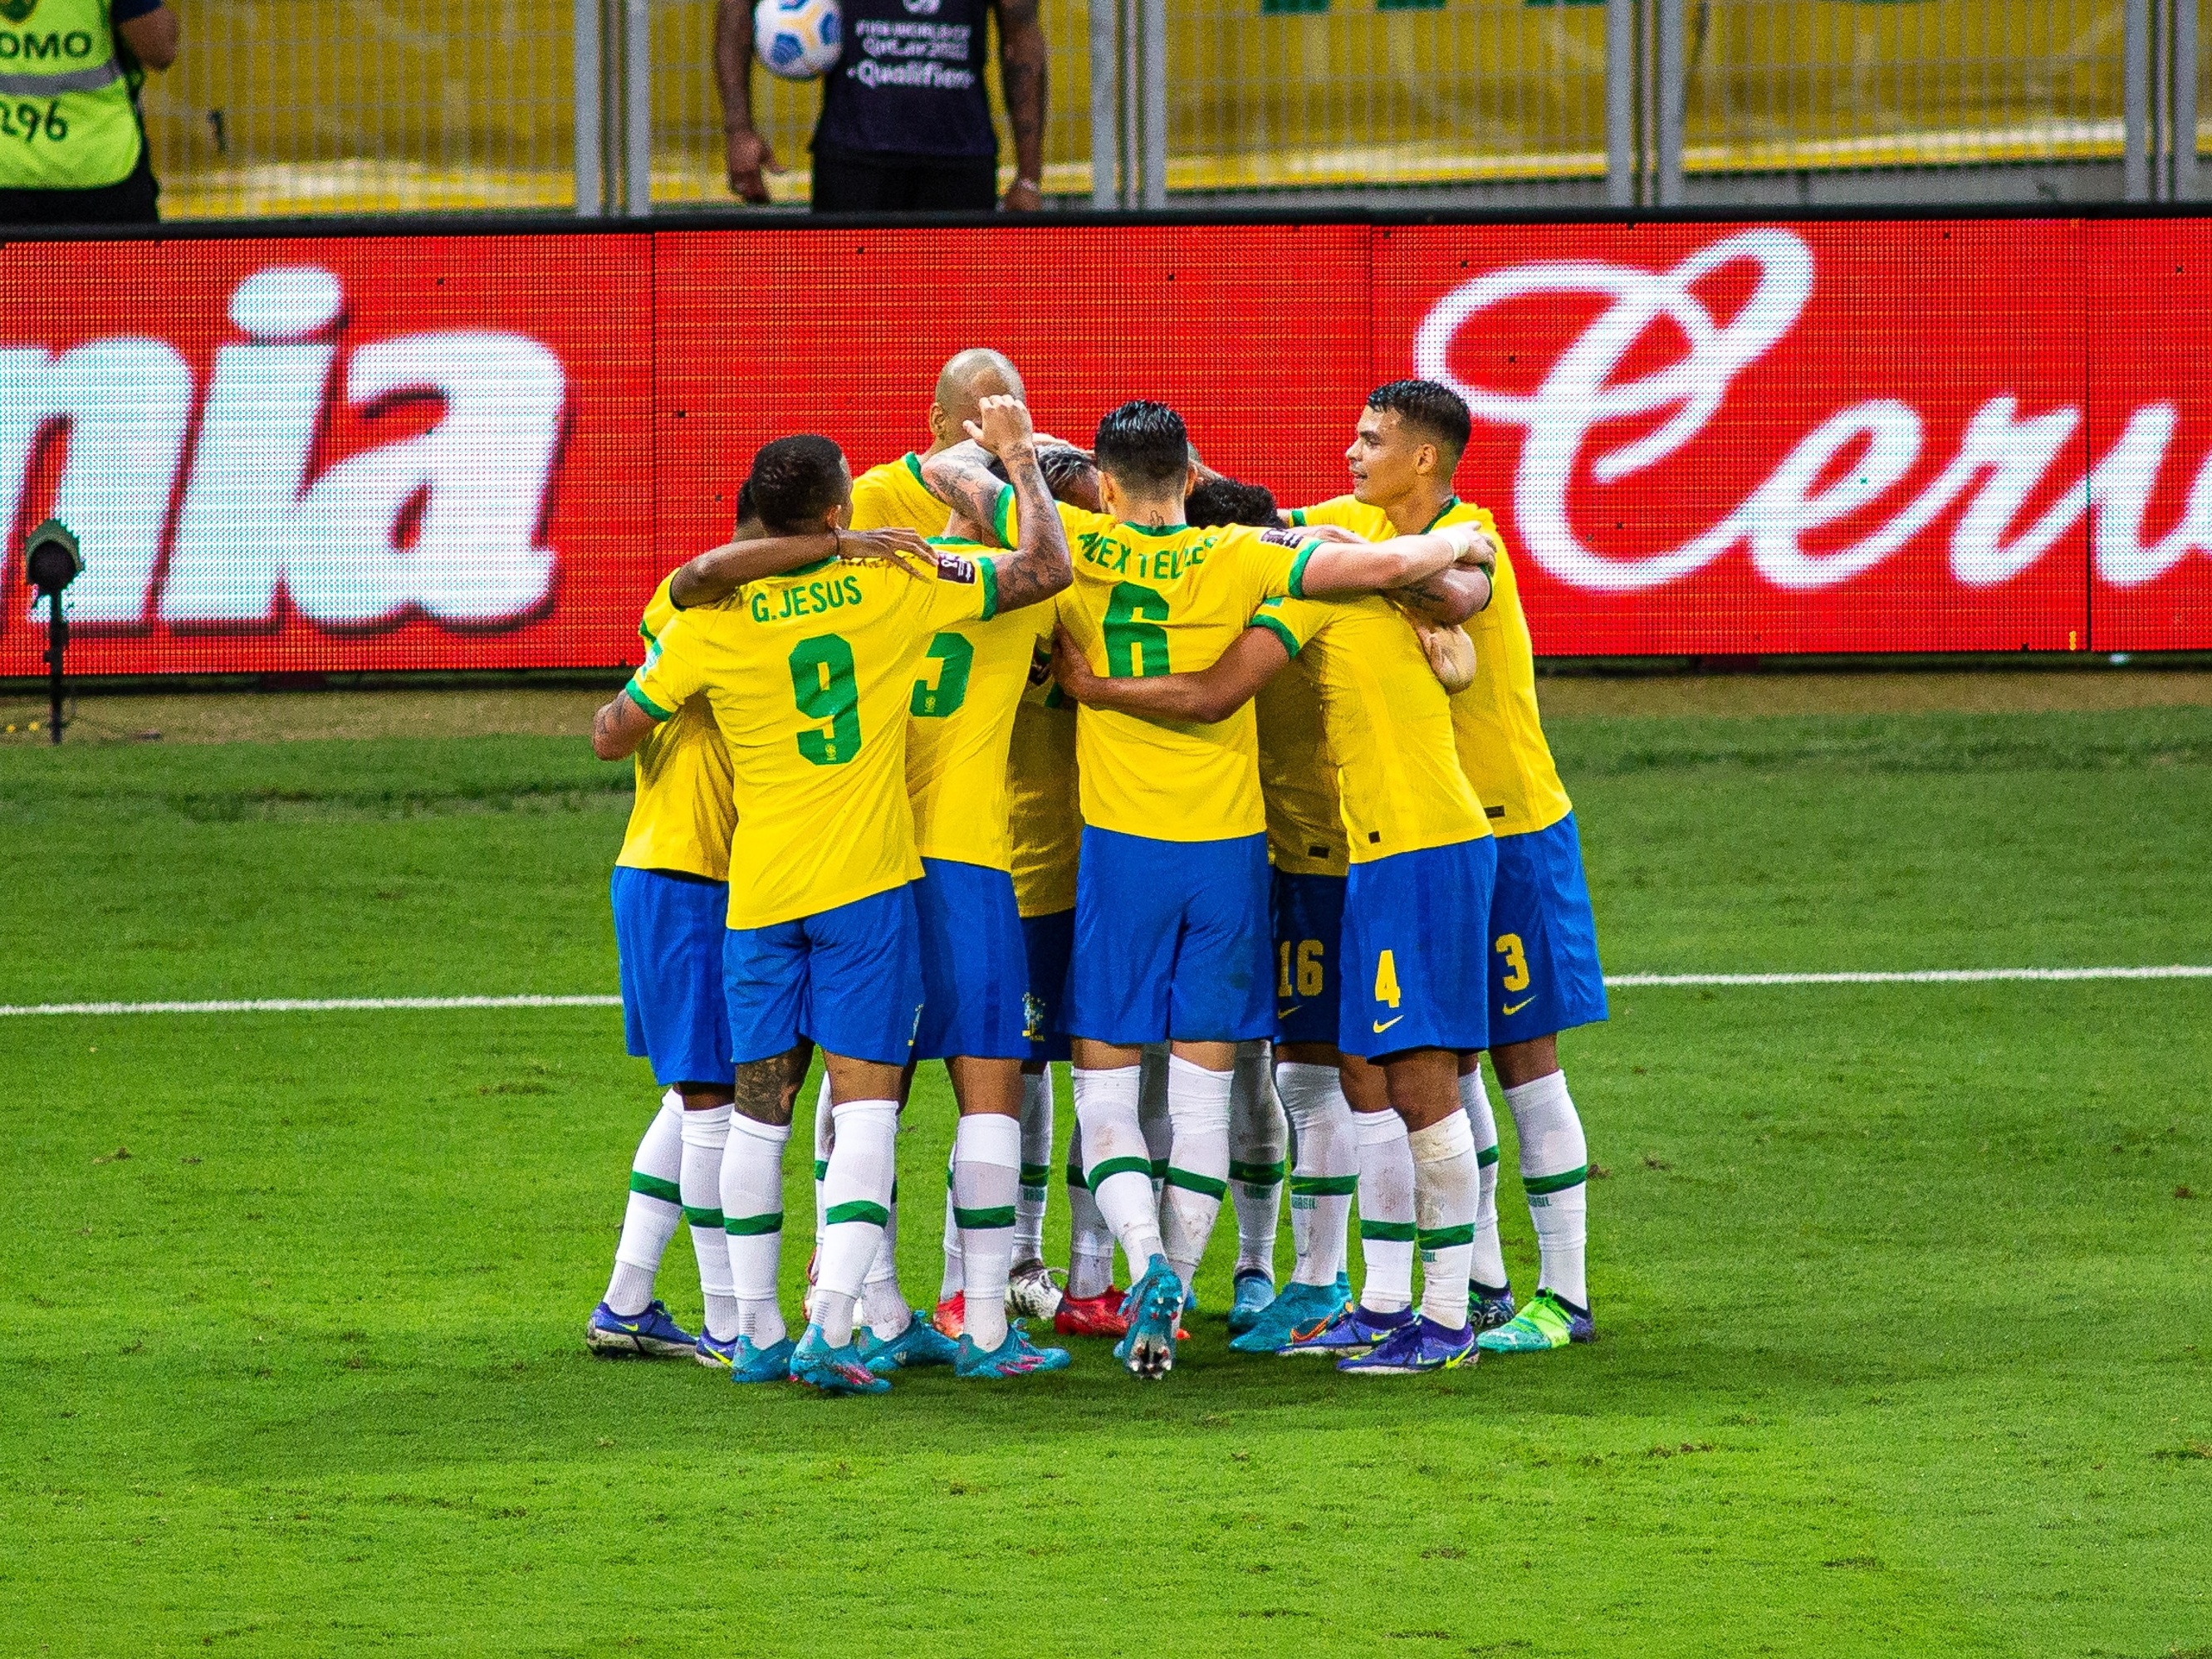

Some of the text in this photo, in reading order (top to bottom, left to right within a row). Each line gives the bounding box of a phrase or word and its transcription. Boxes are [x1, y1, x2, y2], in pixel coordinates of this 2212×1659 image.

[751, 575, 862, 623] G.JESUS
[1102, 580, 1172, 678] 6
[788, 632, 862, 766] 9
[1278, 939, 1324, 997] 16
[1374, 949, 1401, 1008] 4
[1495, 932, 1530, 992] 3
